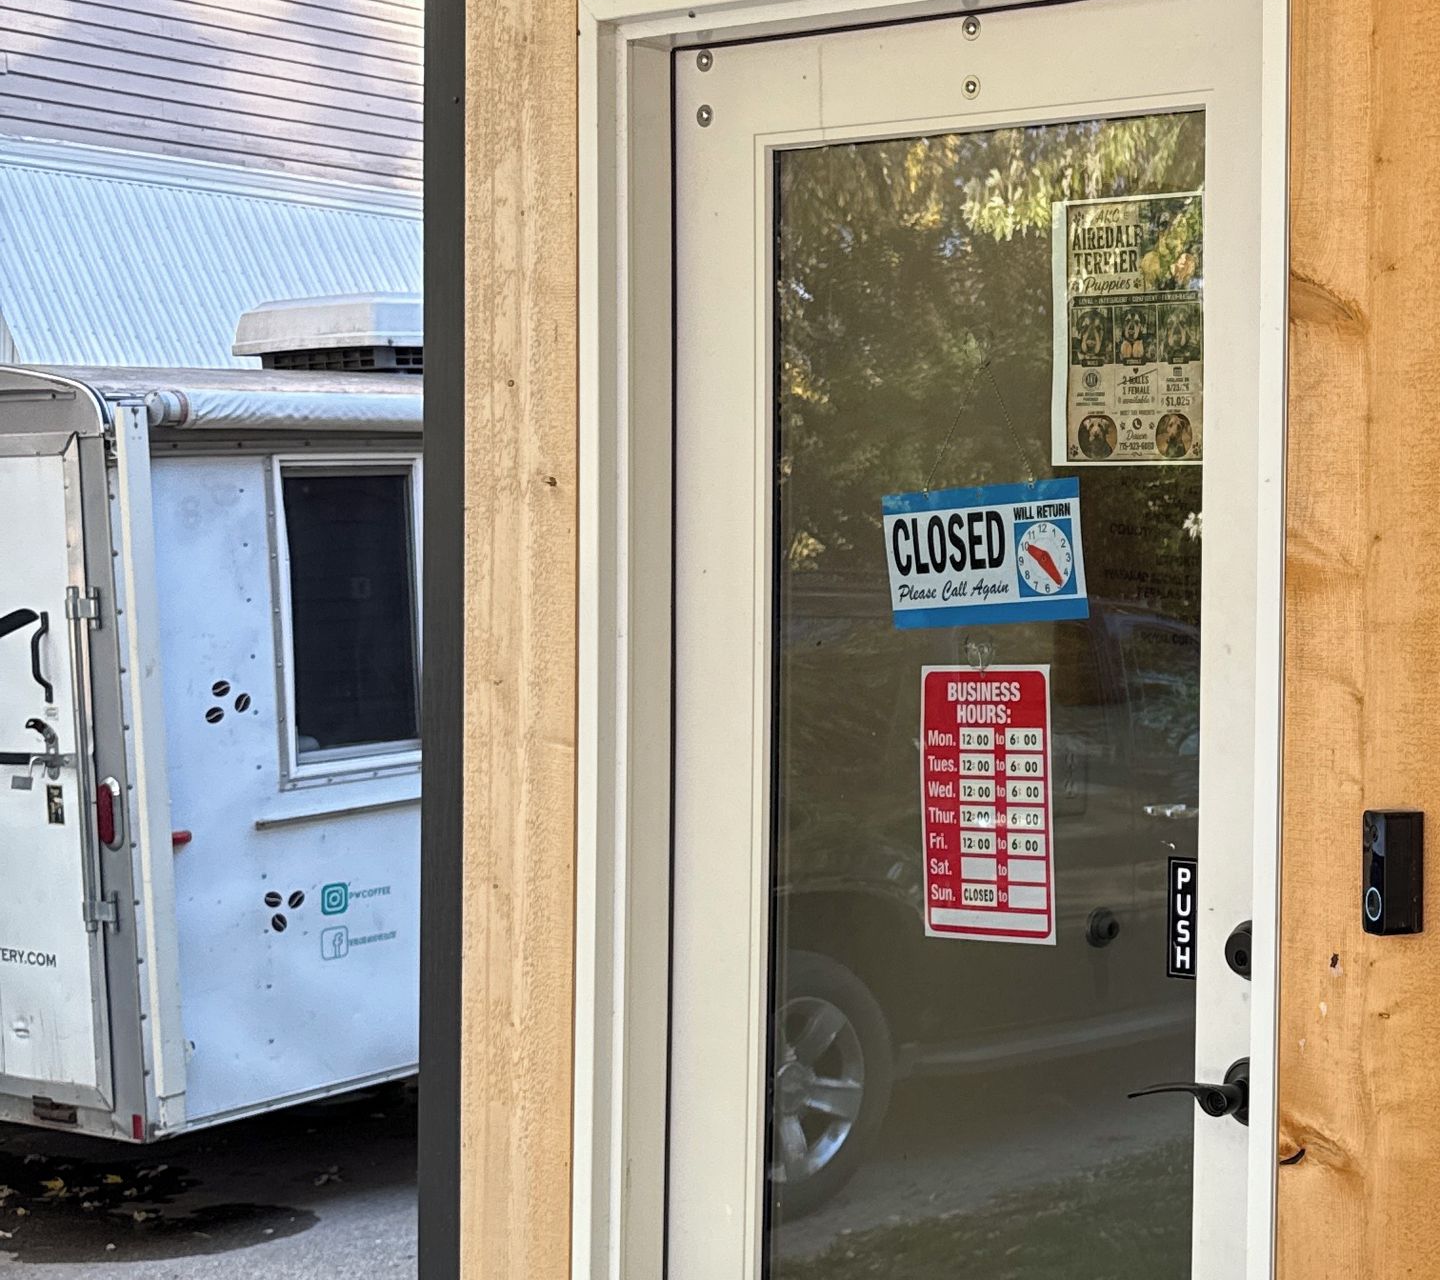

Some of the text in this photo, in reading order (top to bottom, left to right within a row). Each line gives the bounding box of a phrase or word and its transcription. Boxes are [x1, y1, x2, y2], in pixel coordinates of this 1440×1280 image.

[1074, 250, 1138, 275] TERRIER
[1083, 276, 1131, 294] Puppies
[1122, 386, 1151, 395] 1 FEMALE
[1165, 396, 1190, 407] $1,025
[1013, 502, 1071, 521] WILL RETURN
[1027, 530, 1036, 540] 11
[1038, 523, 1047, 533] 12
[1052, 528, 1056, 536] 1
[892, 511, 1006, 576] CLOSED
[1020, 541, 1030, 551] 10
[1060, 539, 1066, 548] 2
[1018, 556, 1024, 566] 9
[1066, 553, 1071, 562] 3
[1024, 570, 1030, 580] 8
[1063, 568, 1069, 577] 4
[898, 578, 1009, 602] Please Call Again
[1033, 581, 1039, 590] 7
[1045, 583, 1051, 593] 6
[947, 681, 1021, 702] BUSINESS
[956, 703, 1012, 724] HOURS:
[927, 729, 957, 746] Mon.
[995, 732, 1005, 745] to
[927, 755, 958, 772] Tues.
[996, 758, 1006, 771] to
[928, 781, 956, 798] Wed.
[996, 785, 1006, 797] to
[928, 807, 957, 824] Thur.
[997, 812, 1007, 824] to
[929, 832, 948, 850] Fri.
[998, 837, 1007, 850] to
[930, 858, 1008, 876] Sat. to
[930, 883, 1008, 903] Sun. CLOSED to
[1176, 867, 1191, 969] PUSH
